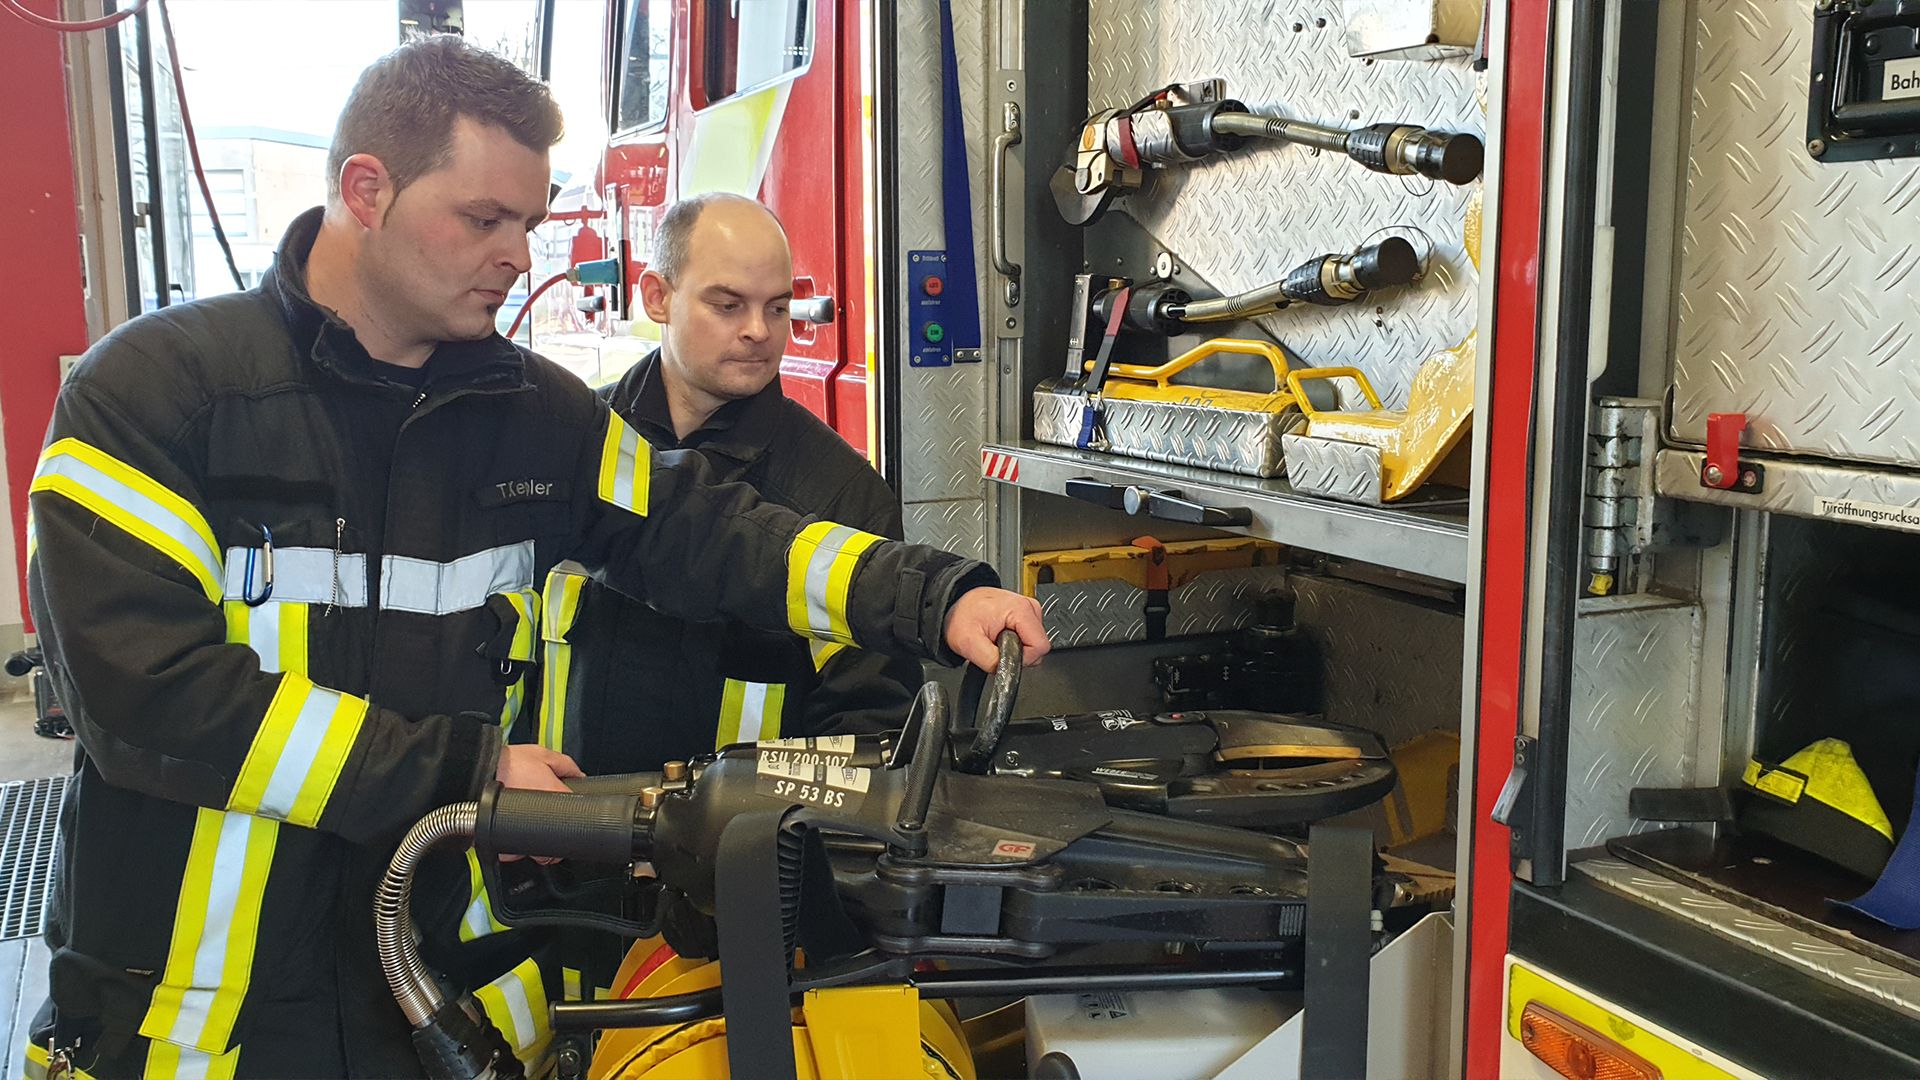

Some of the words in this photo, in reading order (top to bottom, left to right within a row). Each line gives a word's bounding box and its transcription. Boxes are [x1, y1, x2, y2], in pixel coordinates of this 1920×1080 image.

[760, 750, 789, 763] RSU
[793, 752, 849, 768] 200-107
[774, 780, 796, 796] SP
[799, 784, 820, 802] 53
[823, 789, 845, 807] BS
